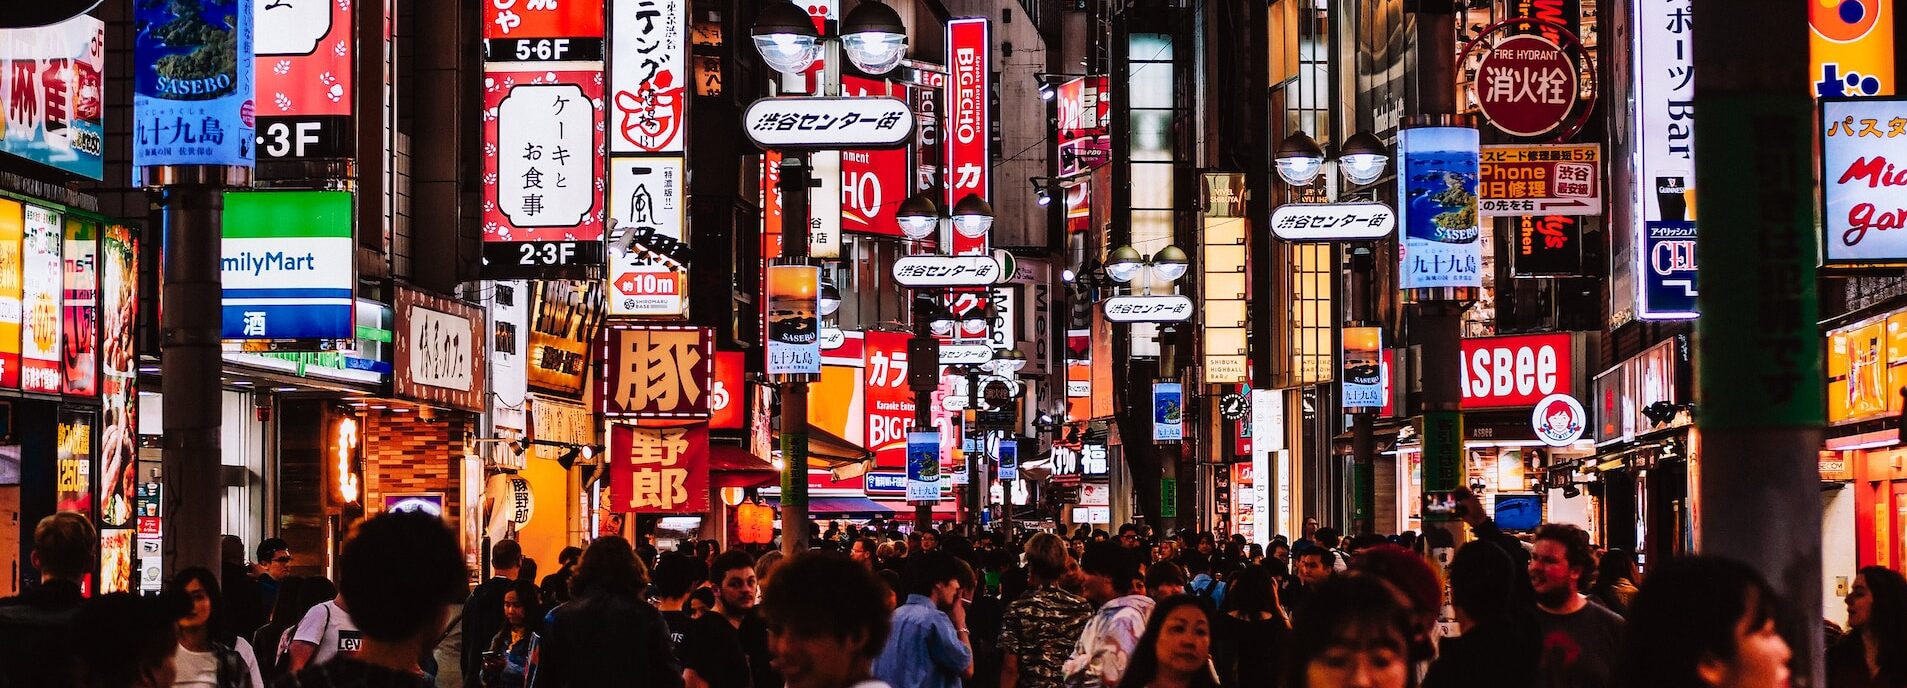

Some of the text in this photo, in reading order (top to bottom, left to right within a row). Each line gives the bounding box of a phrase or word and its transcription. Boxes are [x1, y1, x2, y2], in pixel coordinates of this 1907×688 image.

[1494, 50, 1559, 60] FIRE HYDRANT
[156, 73, 231, 95] SASEBO
[1486, 67, 1567, 104] 消火栓
[957, 48, 975, 144] BIG ECHO
[136, 115, 224, 146] 九十九島
[753, 111, 904, 131] 渋谷センター街
[551, 95, 570, 188] ケーキと
[843, 151, 870, 164] nment
[521, 142, 545, 217] お食事
[1559, 166, 1589, 181] 渋谷
[1278, 214, 1389, 229] 渋谷センター街
[1434, 225, 1478, 240] SASEBO
[898, 264, 993, 277] 渋谷センター街
[1412, 254, 1477, 274] 九十九島
[1110, 304, 1187, 314] 渋谷センター街
[243, 311, 266, 336] 酒
[782, 332, 816, 342] SASEBO
[771, 351, 814, 365] 九十九島
[615, 330, 701, 411] 豚
[868, 351, 909, 388] カラ
[1460, 344, 1557, 398] ASBee
[876, 400, 899, 411] Karaoke
[1346, 390, 1378, 400] 九十九島
[870, 414, 901, 448] BIG
[629, 427, 690, 510] 野郎
[1080, 444, 1106, 475] 福
[511, 478, 529, 524] 豚野郎
[910, 486, 938, 495] 九十九島
